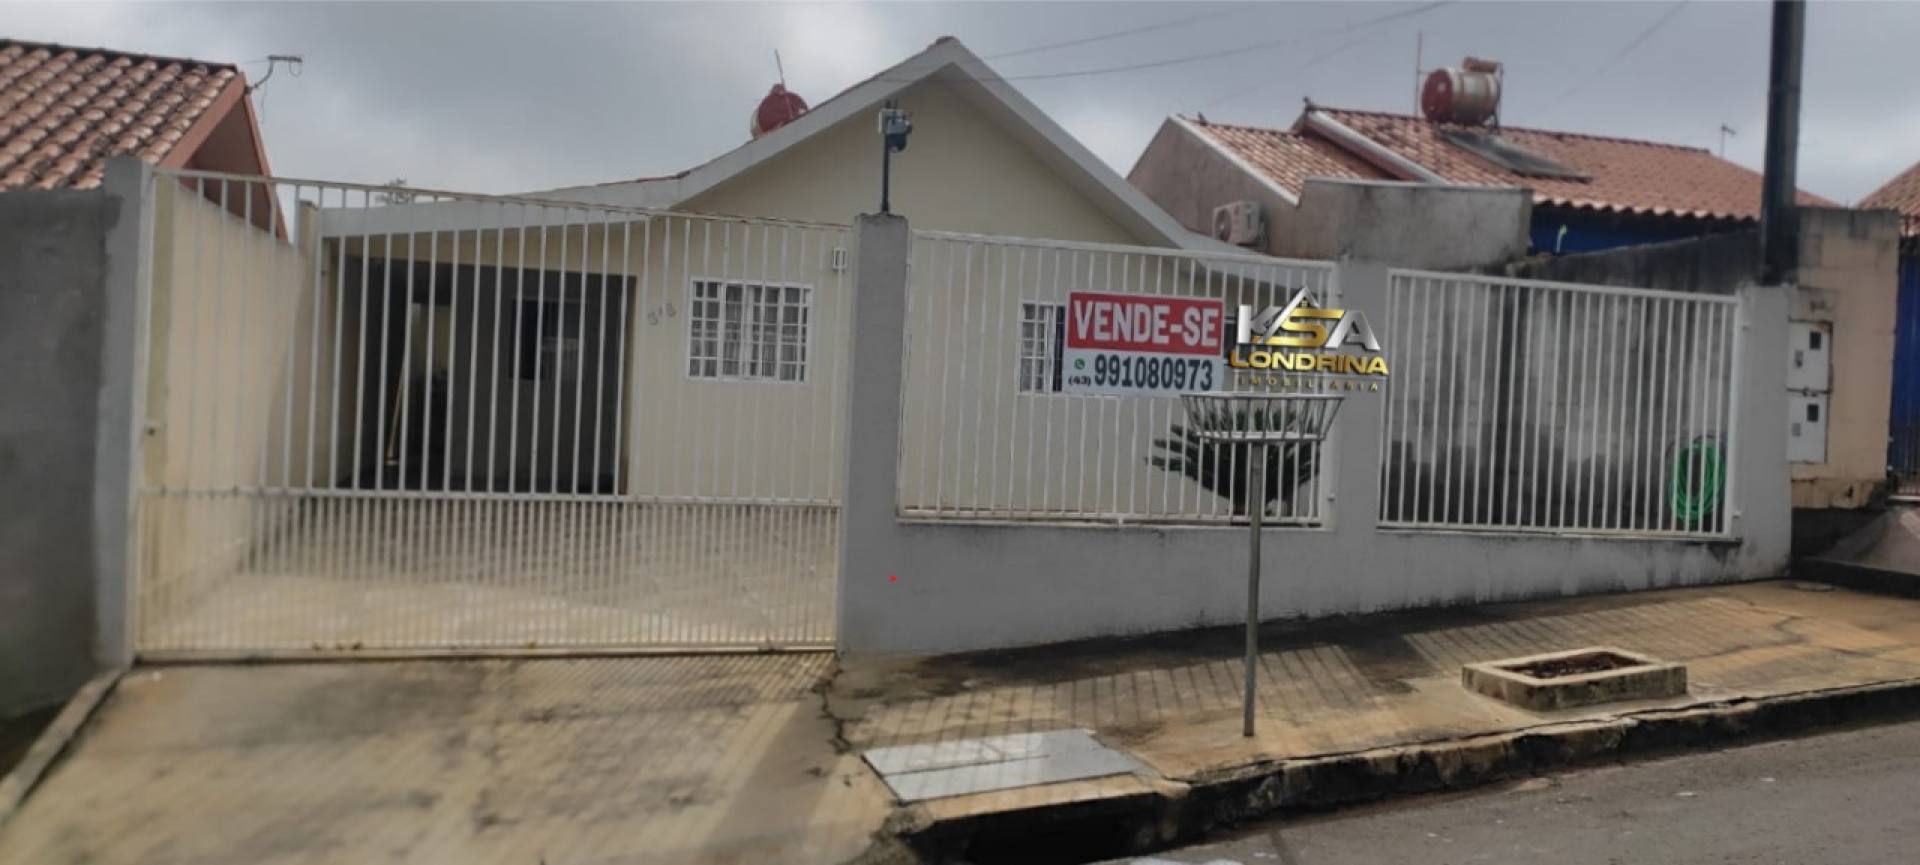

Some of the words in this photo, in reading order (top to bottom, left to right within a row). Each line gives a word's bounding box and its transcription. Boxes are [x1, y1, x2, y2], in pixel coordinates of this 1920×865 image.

[1073, 300, 1219, 347] VENDE-SE
[1068, 375, 1091, 386] (43)
[1095, 354, 1213, 391] 991080973
